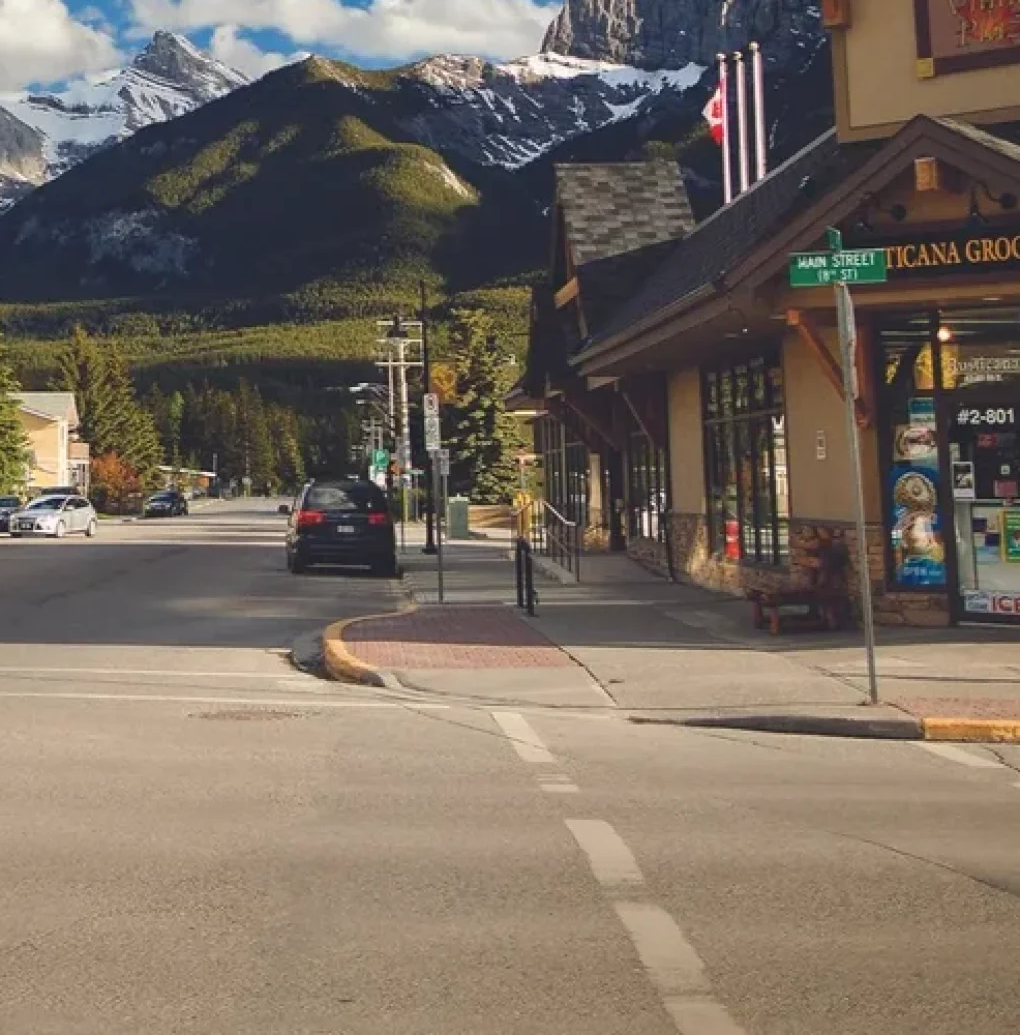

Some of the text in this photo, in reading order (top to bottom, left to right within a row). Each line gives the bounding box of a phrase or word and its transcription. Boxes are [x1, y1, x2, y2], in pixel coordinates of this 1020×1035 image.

[798, 251, 876, 269] MAIN STREET
[957, 408, 1015, 424] #2-801
